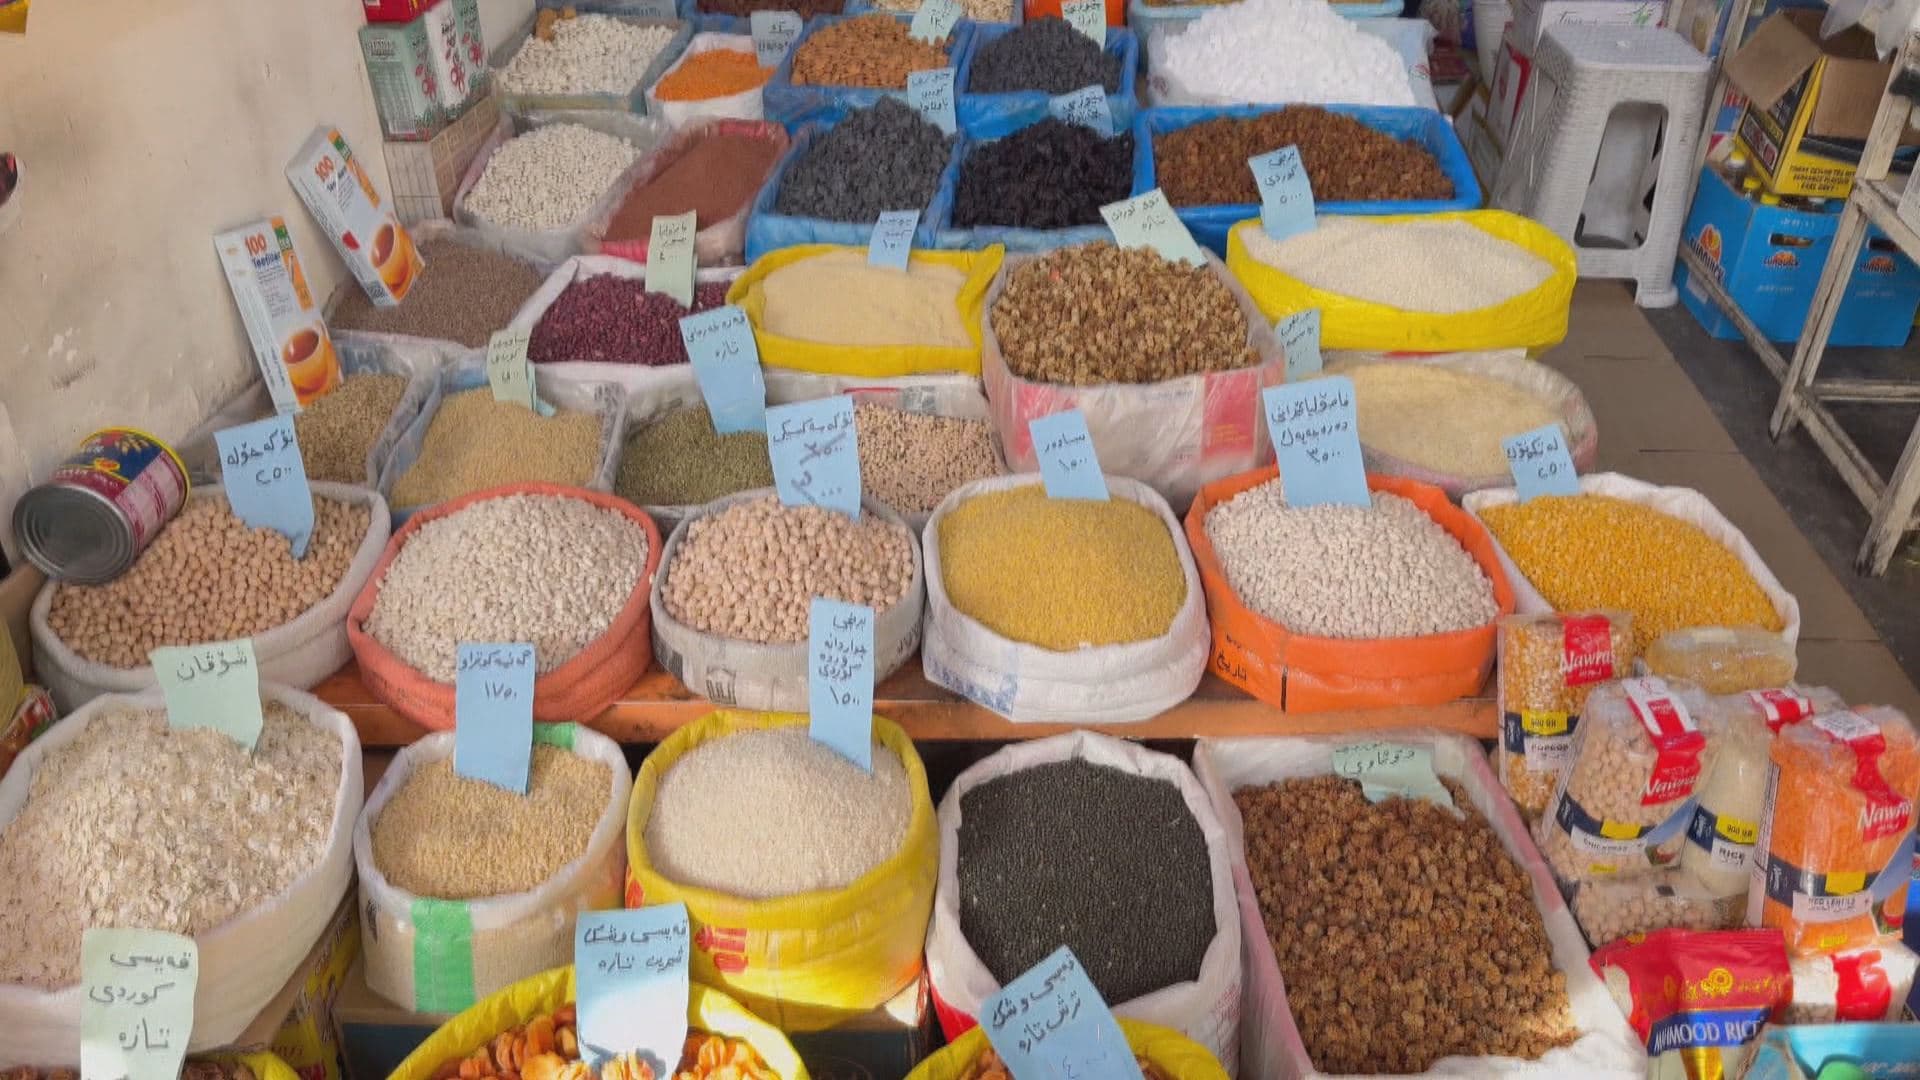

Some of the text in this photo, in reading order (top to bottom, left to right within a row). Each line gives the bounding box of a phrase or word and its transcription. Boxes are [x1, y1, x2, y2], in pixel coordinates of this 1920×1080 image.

[245, 233, 267, 257] 100
[1719, 847, 1746, 860] RICE
[88, 981, 176, 1006] کوردی
[118, 1017, 171, 1052] تازە
